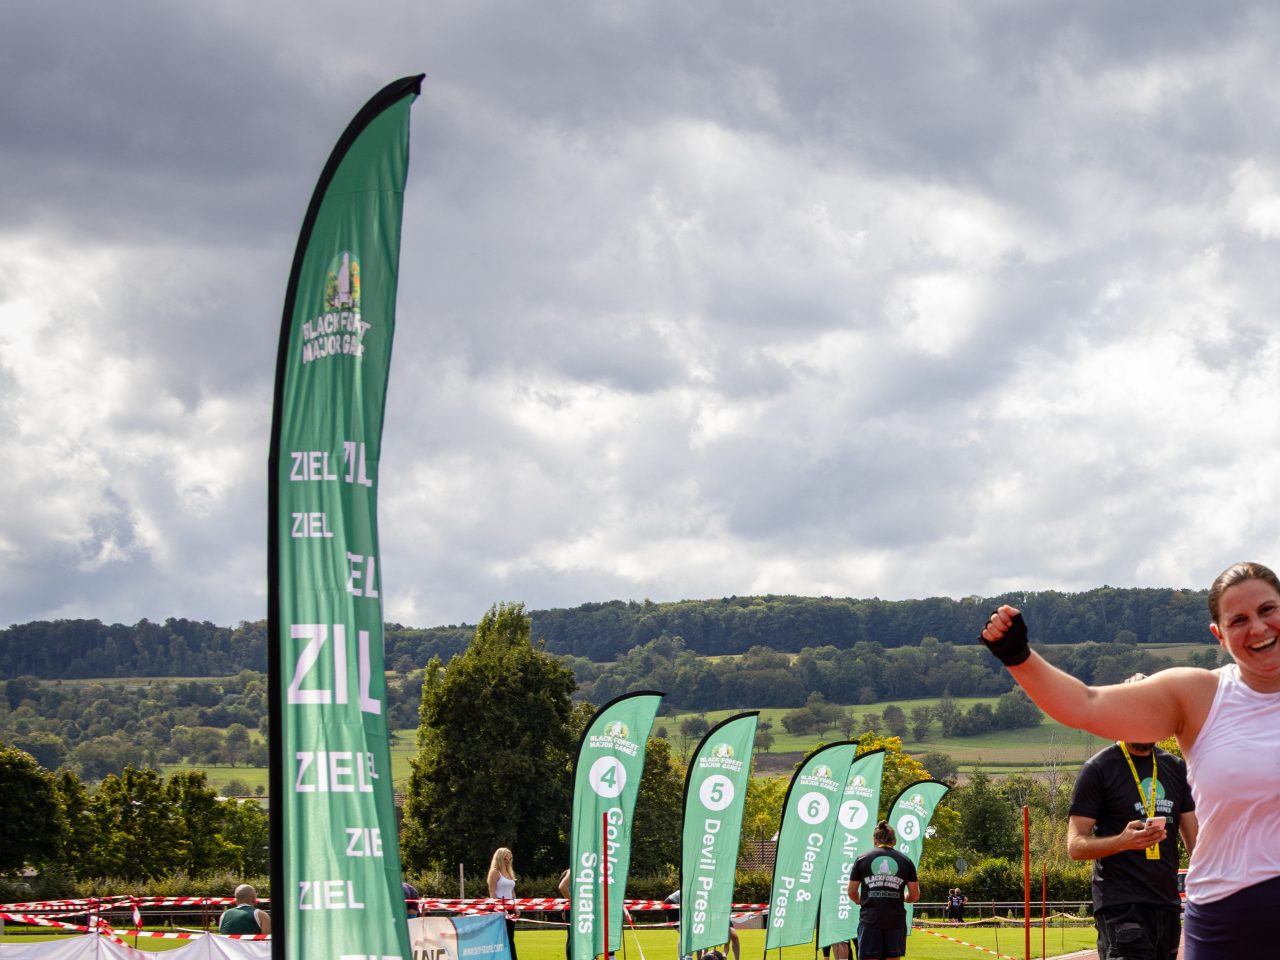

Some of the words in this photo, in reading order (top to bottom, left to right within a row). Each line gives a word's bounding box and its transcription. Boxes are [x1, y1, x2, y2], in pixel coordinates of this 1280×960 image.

[290, 452, 337, 480] ZIEL
[291, 512, 333, 537] ZIEL
[288, 624, 381, 714] ZIL
[295, 752, 374, 792] ZIEL
[600, 766, 616, 788] 4
[710, 783, 724, 802] 5
[807, 800, 820, 818] 6
[848, 806, 860, 822] 7
[904, 821, 914, 835] 8
[345, 828, 383, 857] ZIE
[699, 819, 721, 869] Devil
[843, 832, 858, 858] Air
[799, 833, 824, 884] Clean
[299, 880, 364, 909] ZIEL
[575, 852, 597, 934] Squats
[692, 876, 714, 934] Press
[773, 876, 795, 928] Press
[796, 889, 811, 902] &
